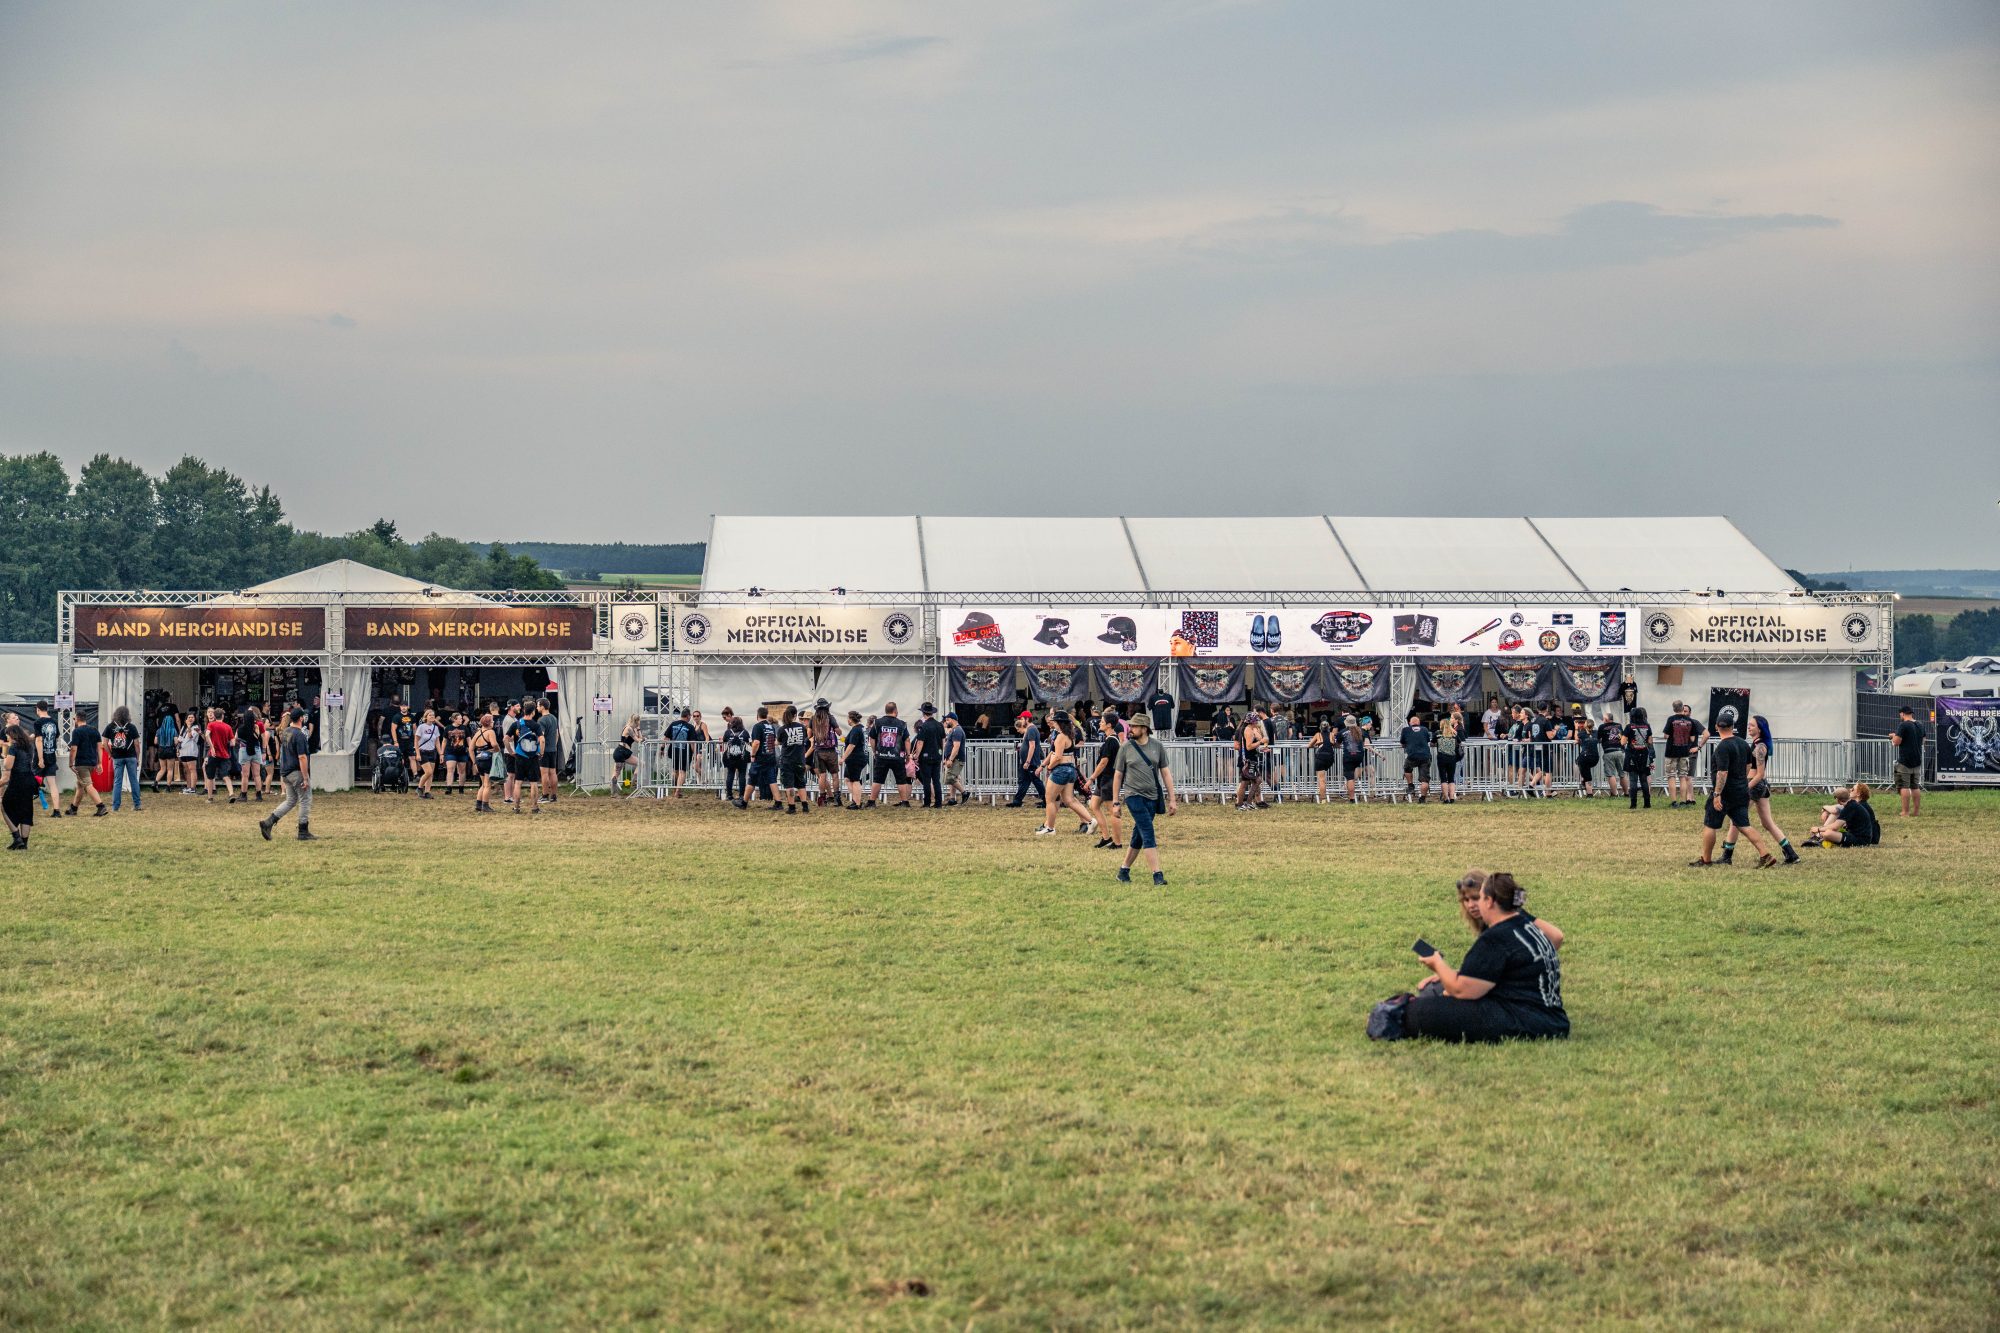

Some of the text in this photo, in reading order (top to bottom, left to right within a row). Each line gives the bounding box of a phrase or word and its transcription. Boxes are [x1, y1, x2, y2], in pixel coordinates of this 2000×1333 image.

[745, 615, 826, 628] OFFICIAL
[1707, 615, 1786, 627] OFFICIAL
[96, 622, 303, 637] BAND MERCHANDISE
[366, 622, 571, 637] BAND MERCHANDISE
[727, 629, 868, 643] MERCHANDISE
[1690, 628, 1827, 643] MERCHANDISE
[1945, 709, 1979, 717] SUMMER
[784, 727, 804, 736] WE
